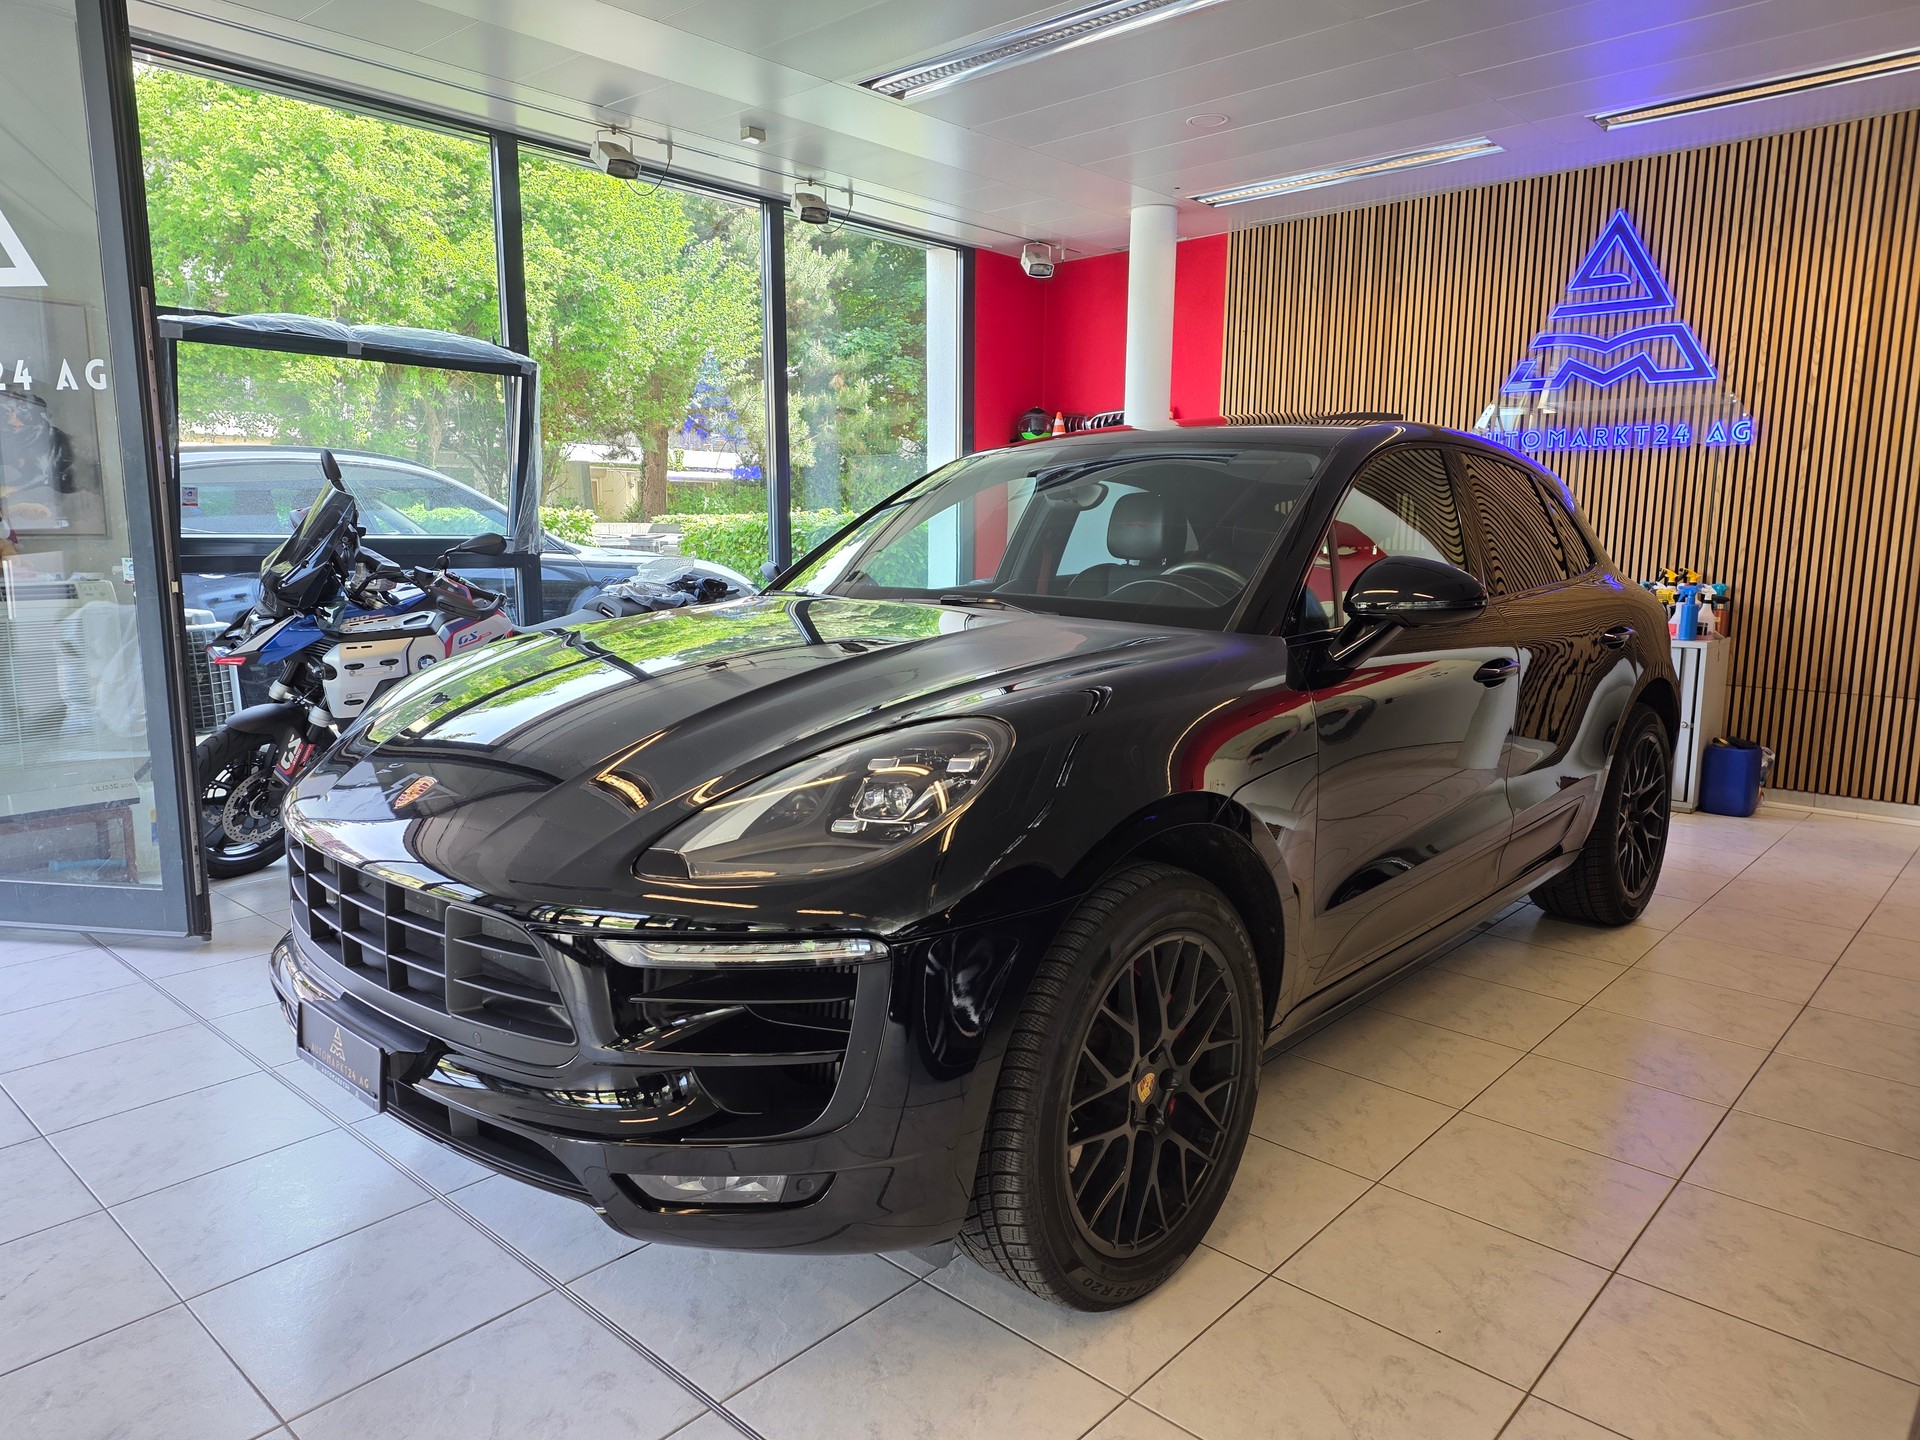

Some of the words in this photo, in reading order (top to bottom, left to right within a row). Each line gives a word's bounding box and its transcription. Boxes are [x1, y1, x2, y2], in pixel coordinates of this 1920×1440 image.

[56, 358, 108, 391] AG
[1485, 422, 1690, 450] UTOMARKT24
[1705, 420, 1751, 444] AG
[458, 630, 478, 645] GS
[280, 733, 302, 770] GS
[310, 1042, 357, 1082] AUTOMARKT24
[358, 1075, 370, 1089] AG
